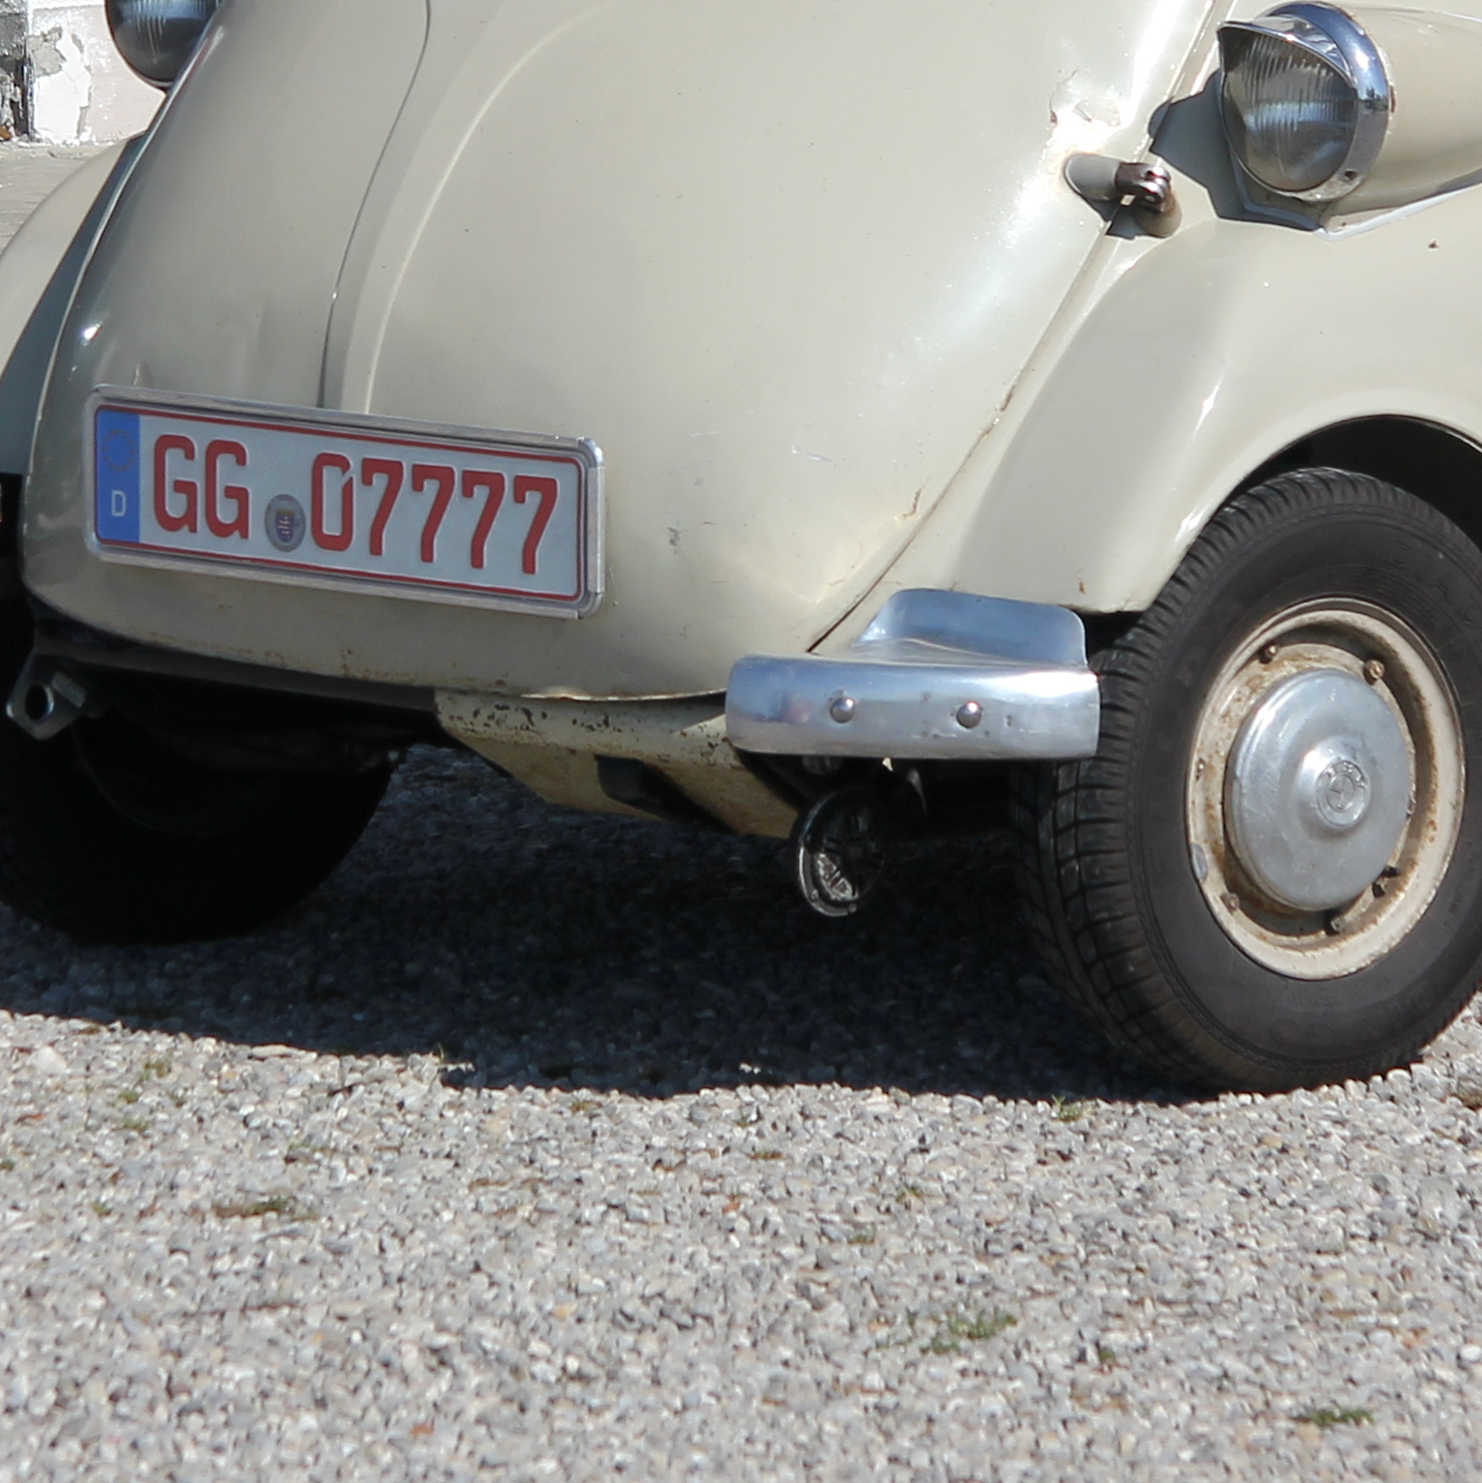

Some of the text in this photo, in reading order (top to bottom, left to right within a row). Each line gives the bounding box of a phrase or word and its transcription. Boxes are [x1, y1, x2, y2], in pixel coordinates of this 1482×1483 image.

[111, 489, 127, 517] D
[153, 433, 559, 575] GG 07777
